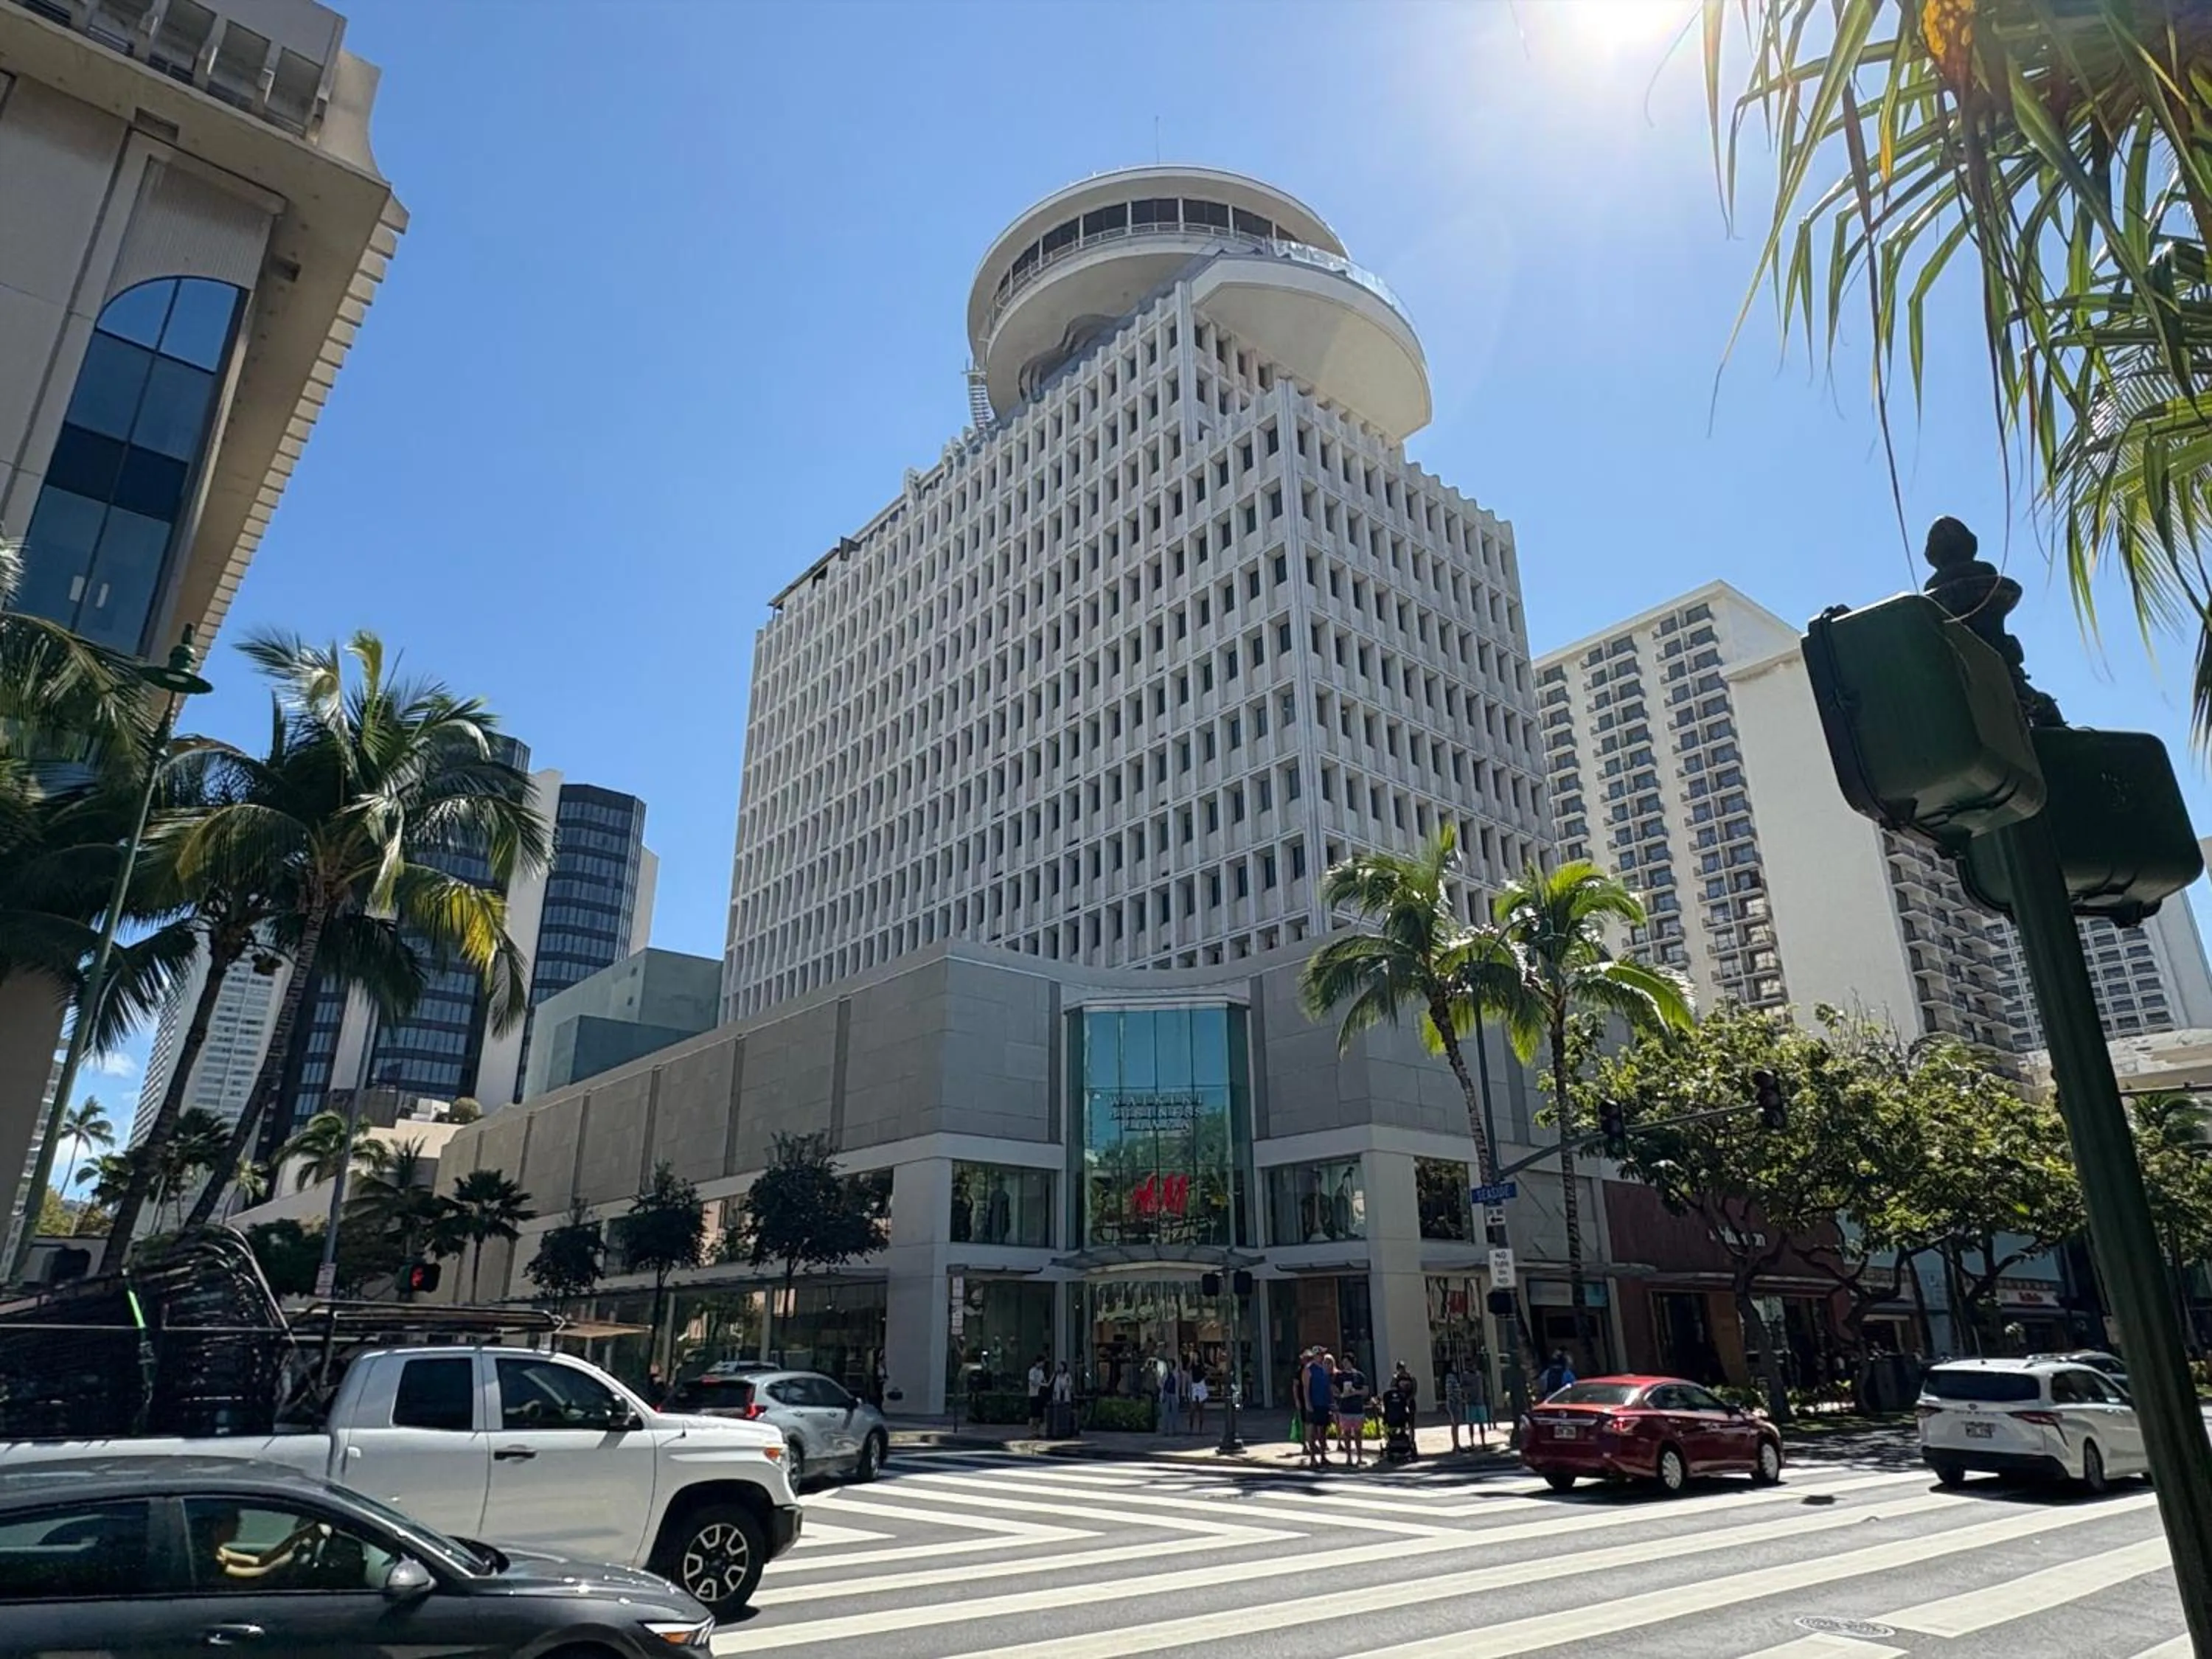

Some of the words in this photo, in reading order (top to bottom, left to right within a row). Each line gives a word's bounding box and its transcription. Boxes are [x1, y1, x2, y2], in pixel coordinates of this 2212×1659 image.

[1108, 1091, 1204, 1106] WAIKIKI
[1108, 1105, 1204, 1120] BUSINESS
[1130, 1169, 1192, 1217] H&M
